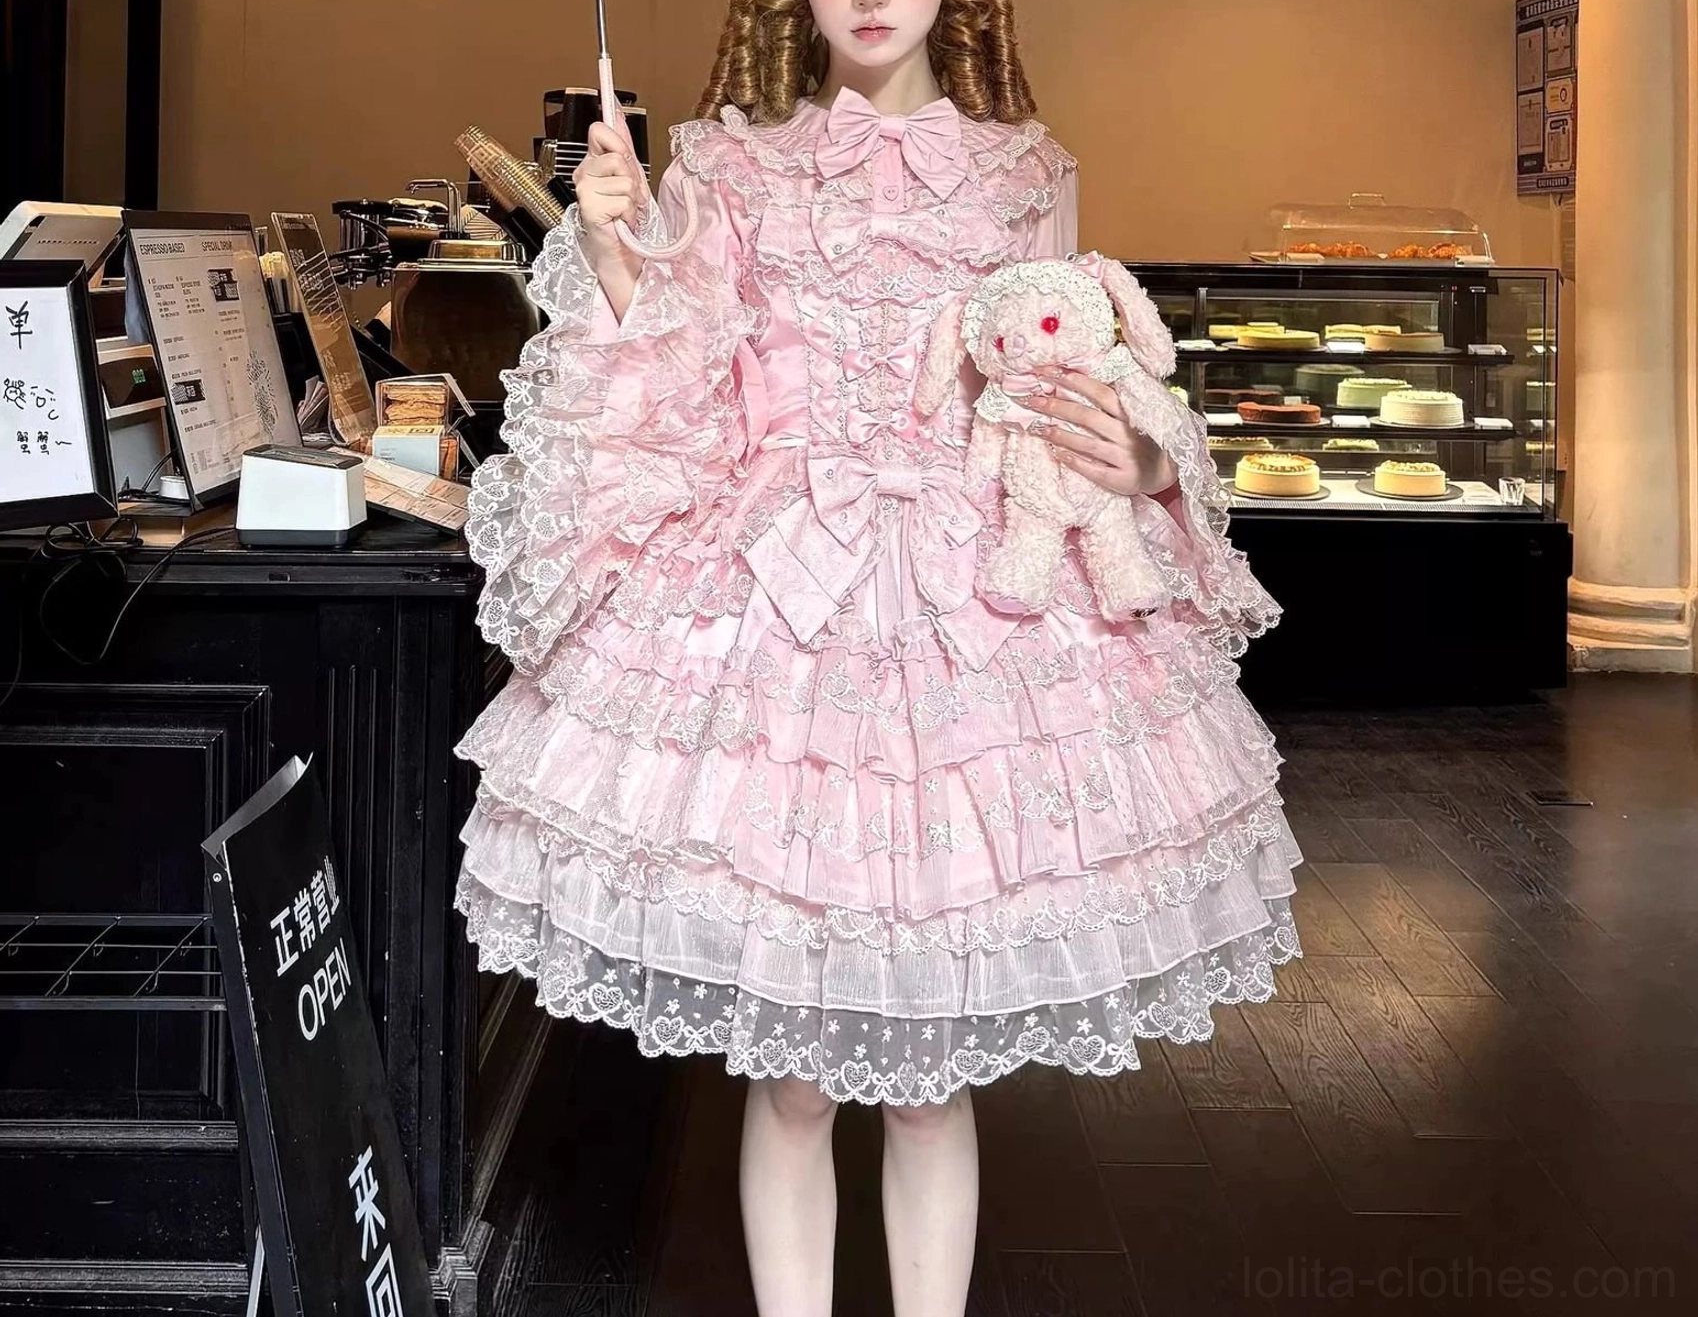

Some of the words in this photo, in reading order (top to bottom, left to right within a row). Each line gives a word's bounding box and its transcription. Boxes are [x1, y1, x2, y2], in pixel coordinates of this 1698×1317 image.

[139, 243, 168, 255] ESPRESSO
[168, 242, 185, 254] BASED
[201, 241, 220, 252] SPECIAL
[298, 937, 351, 1041] OPEN
